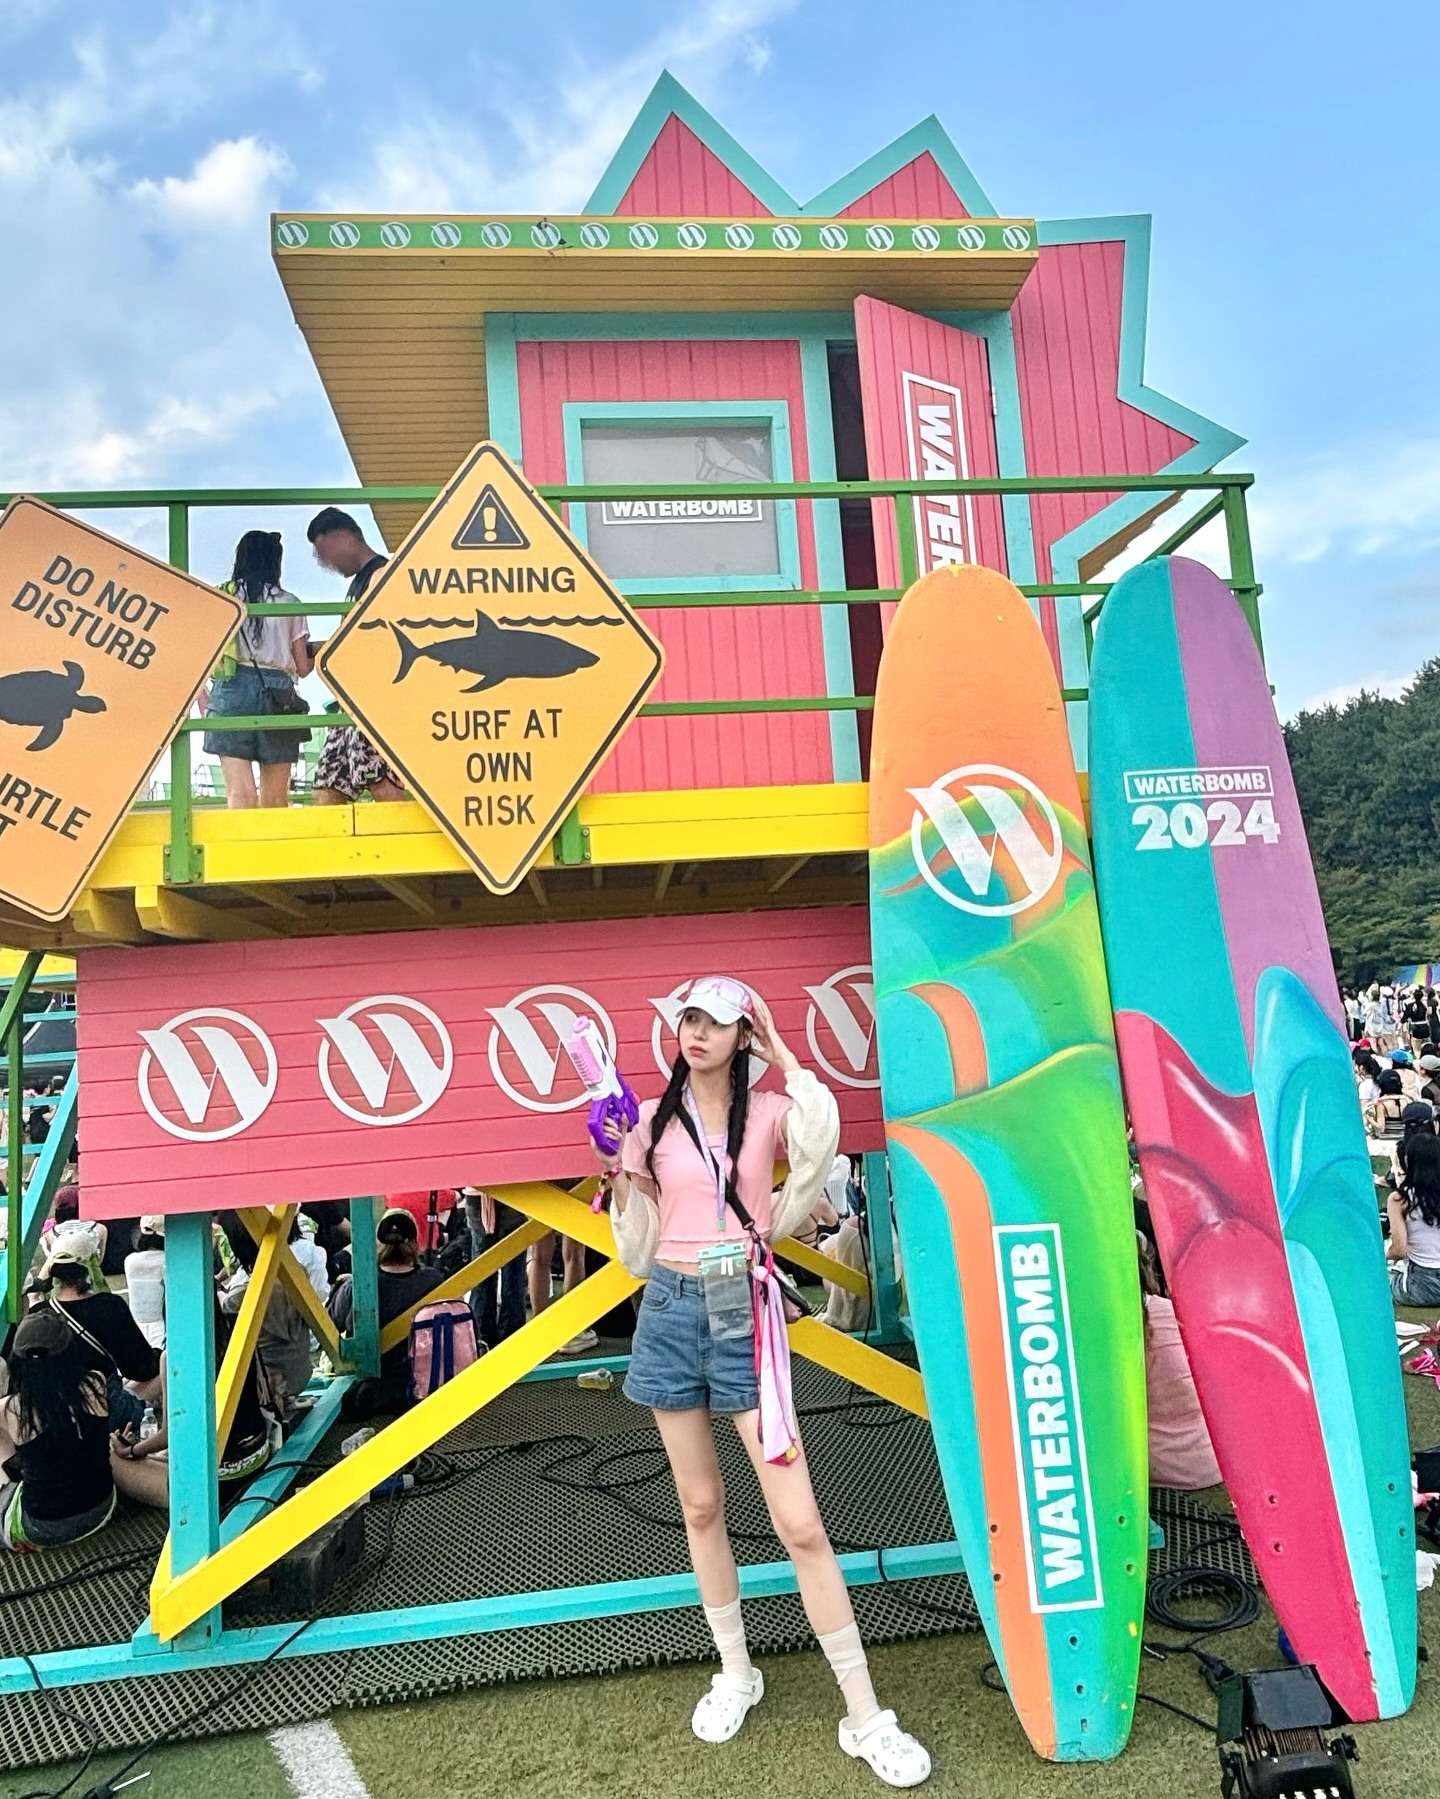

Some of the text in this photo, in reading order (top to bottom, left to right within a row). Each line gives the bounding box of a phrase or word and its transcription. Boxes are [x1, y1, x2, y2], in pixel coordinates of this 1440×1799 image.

[611, 500, 754, 517] WATERBOMB
[43, 554, 170, 633] DO NOT
[408, 566, 576, 594] WARNING
[11, 581, 157, 670] DISTURB
[431, 708, 563, 741] SURF AT
[466, 752, 532, 783] OWN
[1133, 772, 1266, 796] WATERBOMB
[464, 794, 536, 827] RISK
[1131, 799, 1281, 851] 2024
[1010, 1241, 1086, 1589] WATERBOMB
